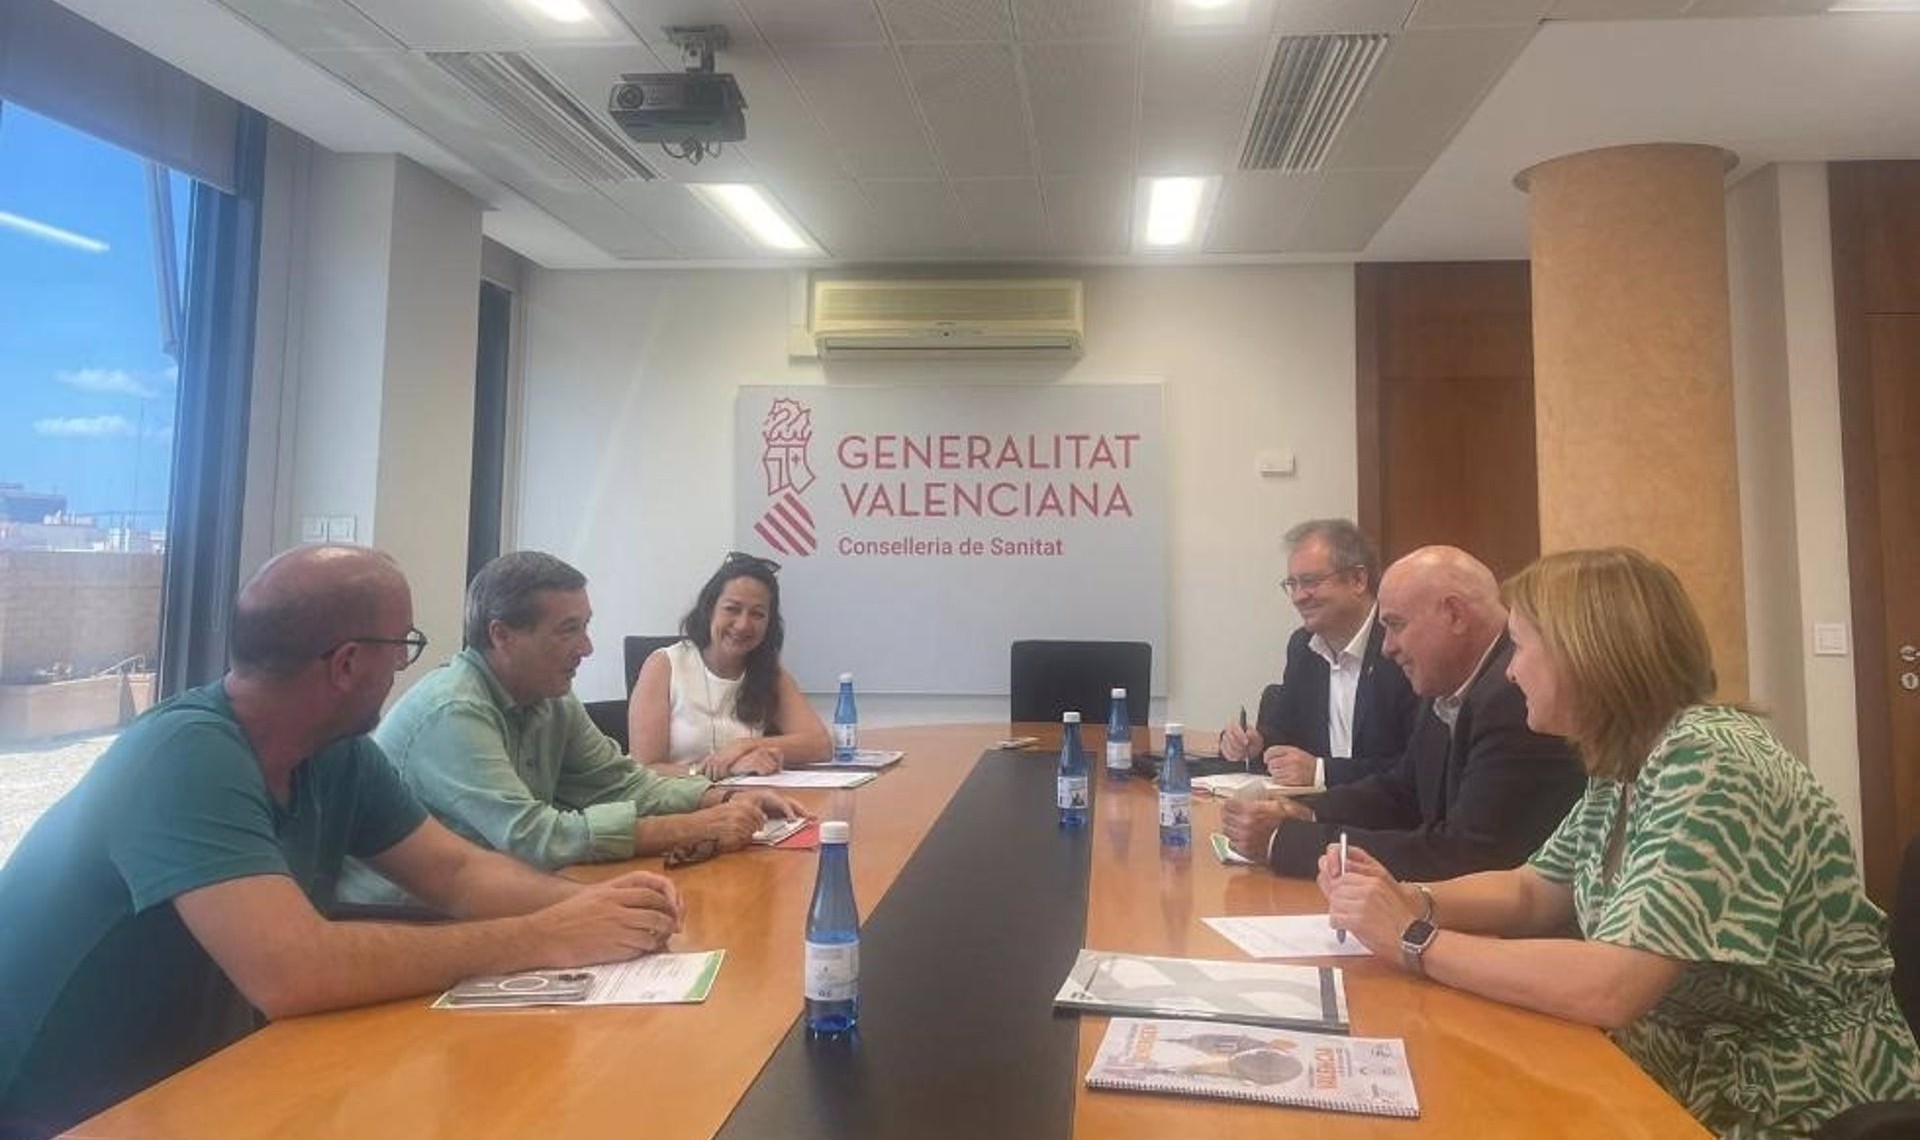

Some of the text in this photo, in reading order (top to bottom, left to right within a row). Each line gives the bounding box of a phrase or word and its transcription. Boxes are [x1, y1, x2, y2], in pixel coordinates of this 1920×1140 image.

[837, 434, 1141, 470] GENERALITAT
[840, 482, 1133, 518] VALENCIANA
[838, 537, 1064, 556] Conselleria de Sanitat
